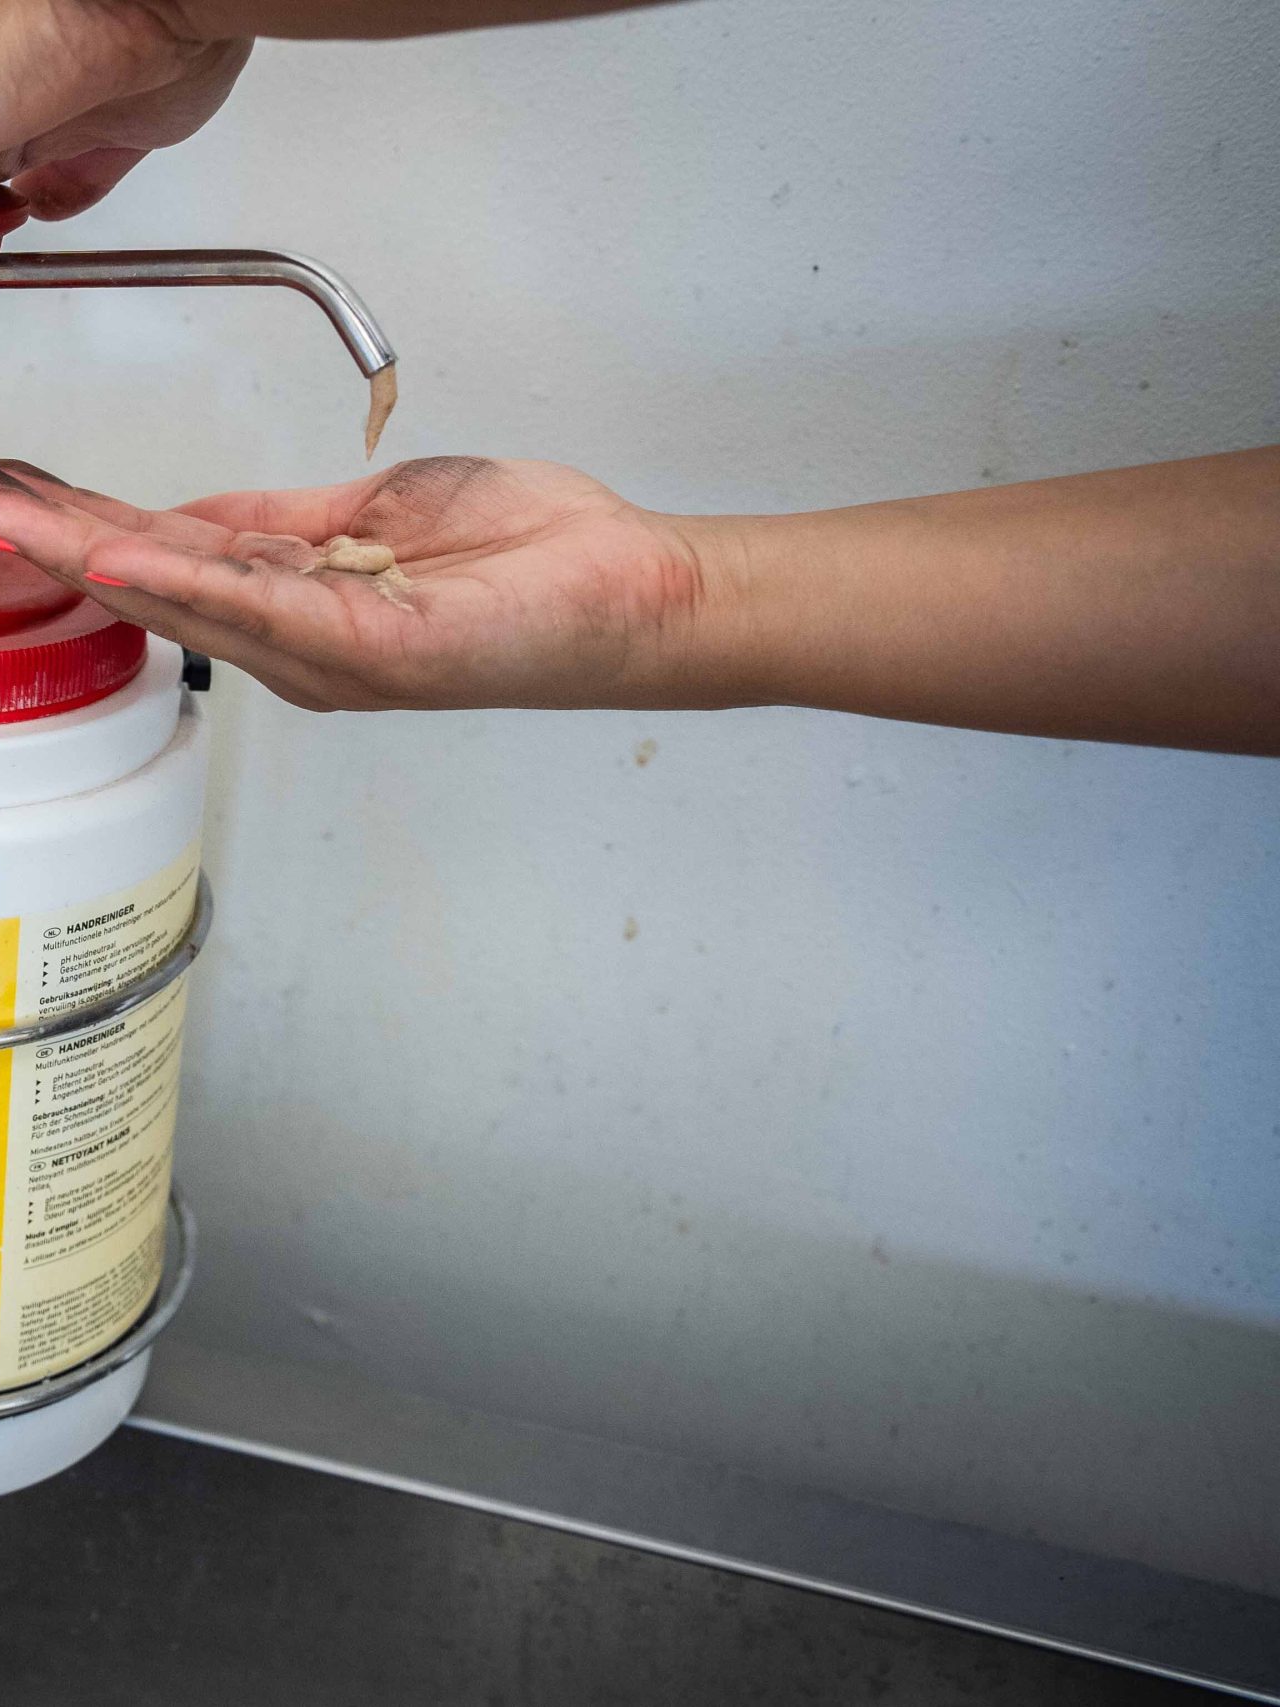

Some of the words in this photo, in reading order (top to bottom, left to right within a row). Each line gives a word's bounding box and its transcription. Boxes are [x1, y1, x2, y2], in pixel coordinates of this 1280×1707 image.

[66, 903, 135, 935] HANDREINIGER
[43, 928, 102, 951] Multifunctionele
[60, 956, 71, 967] pH
[72, 940, 116, 961] huidneutraal
[60, 959, 92, 975] Geschikt
[93, 954, 108, 965] voor
[59, 966, 102, 985] Aangename
[103, 960, 118, 973] geur
[39, 977, 114, 1005] Gebruiksaanwijzing:
[38, 998, 76, 1015] vervuiling
[58, 1022, 126, 1054] HANDREINIGER
[35, 1046, 99, 1071] Multifunktioneller
[52, 1073, 64, 1085] pH
[65, 1059, 104, 1080] hautneutral
[51, 1082, 97, 1102] Angenehmer
[52, 1077, 82, 1093] Entfernt
[32, 1093, 106, 1122] Gebrauchsanleitung:
[46, 1126, 61, 1138] den
[51, 1141, 105, 1168] NETTOYANT
[106, 1125, 131, 1146] MAINS
[28, 1169, 65, 1184] Nettoyant
